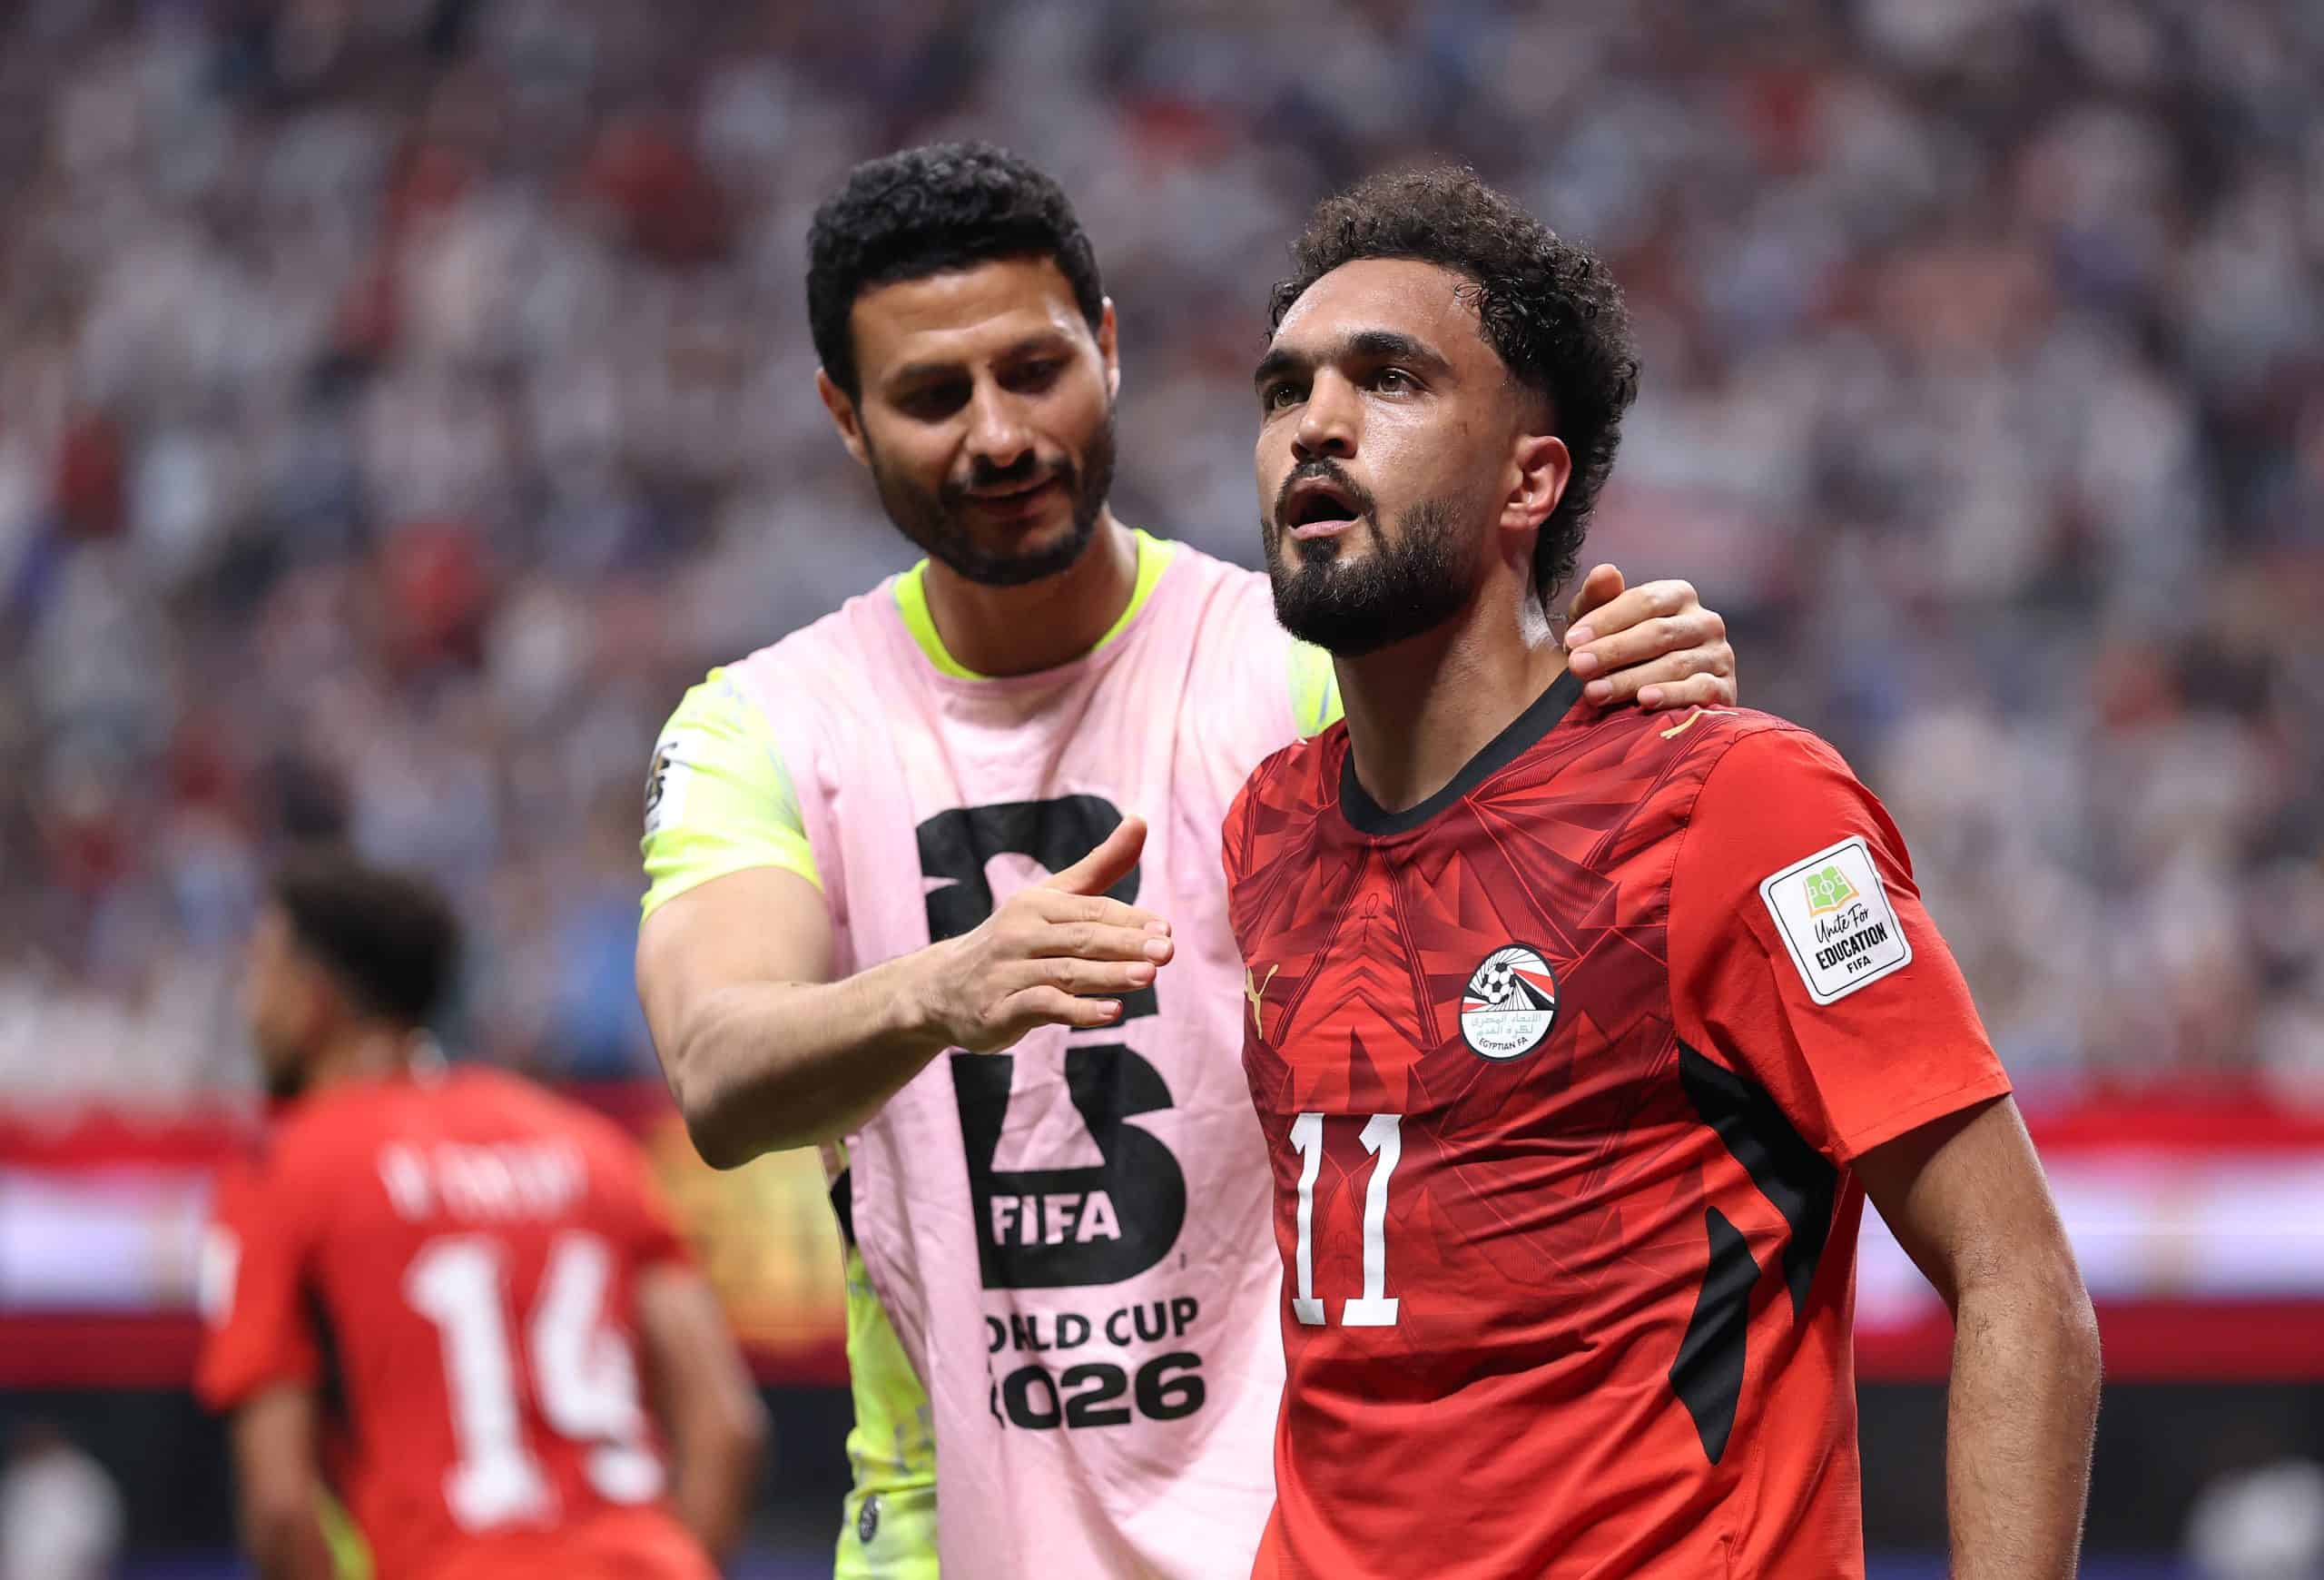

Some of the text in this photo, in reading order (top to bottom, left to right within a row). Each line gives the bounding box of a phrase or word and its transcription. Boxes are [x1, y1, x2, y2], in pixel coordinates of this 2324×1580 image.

[1815, 903, 1870, 943] Unite For
[1816, 922, 1887, 971] EDUCATION
[1846, 956, 1872, 973] FIFA
[1479, 1036, 1528, 1051] EGYPTIAN FA
[990, 1190, 1121, 1245] FIFA
[1289, 1112, 1403, 1326] 11
[1106, 1297, 1198, 1347] CUP
[402, 1228, 667, 1535] 14
[988, 1351, 1206, 1431] 026
